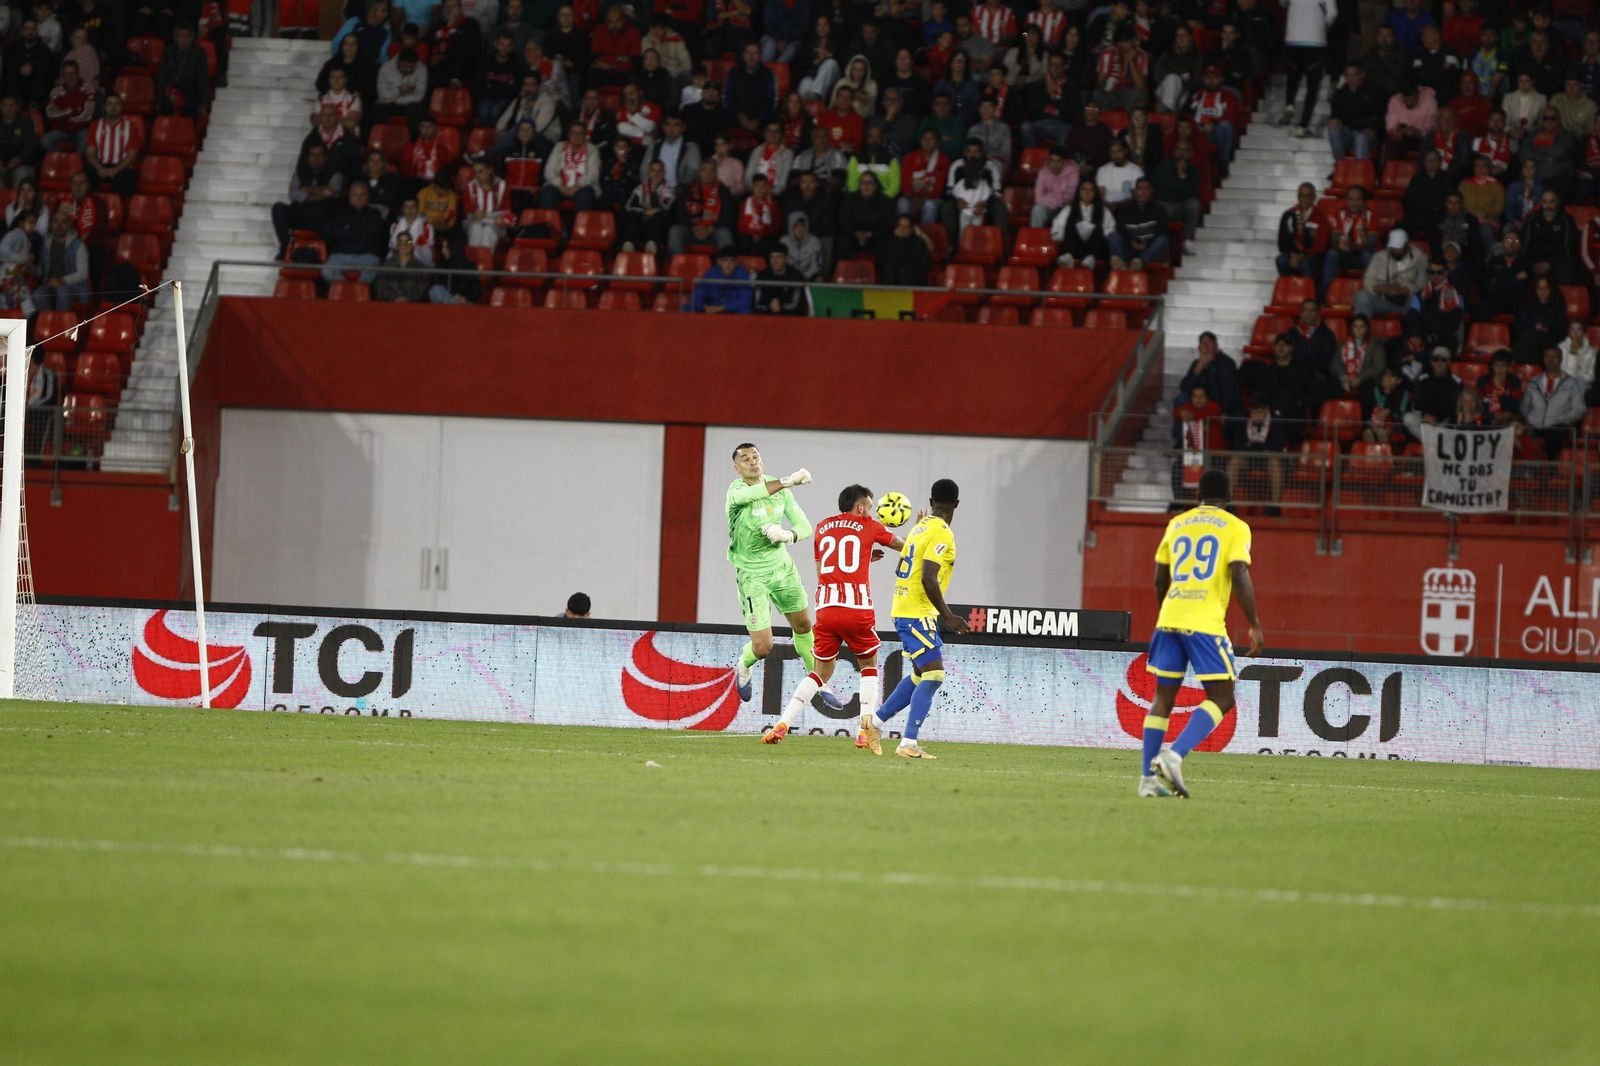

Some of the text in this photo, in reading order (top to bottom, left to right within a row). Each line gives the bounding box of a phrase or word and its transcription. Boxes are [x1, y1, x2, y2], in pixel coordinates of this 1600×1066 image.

[1437, 433, 1502, 461] LOPY
[1469, 463, 1494, 477] DAS
[1428, 489, 1502, 506] CAMISETA?
[1459, 478, 1477, 491] TU
[819, 519, 864, 535] CENTELLES
[819, 535, 861, 574] 20
[1173, 534, 1219, 581] 29
[746, 596, 753, 614] 1
[968, 607, 1078, 637] #FANCAM
[1522, 626, 1600, 655] CIUD
[253, 621, 414, 698] TCI
[1238, 664, 1403, 742] TCI
